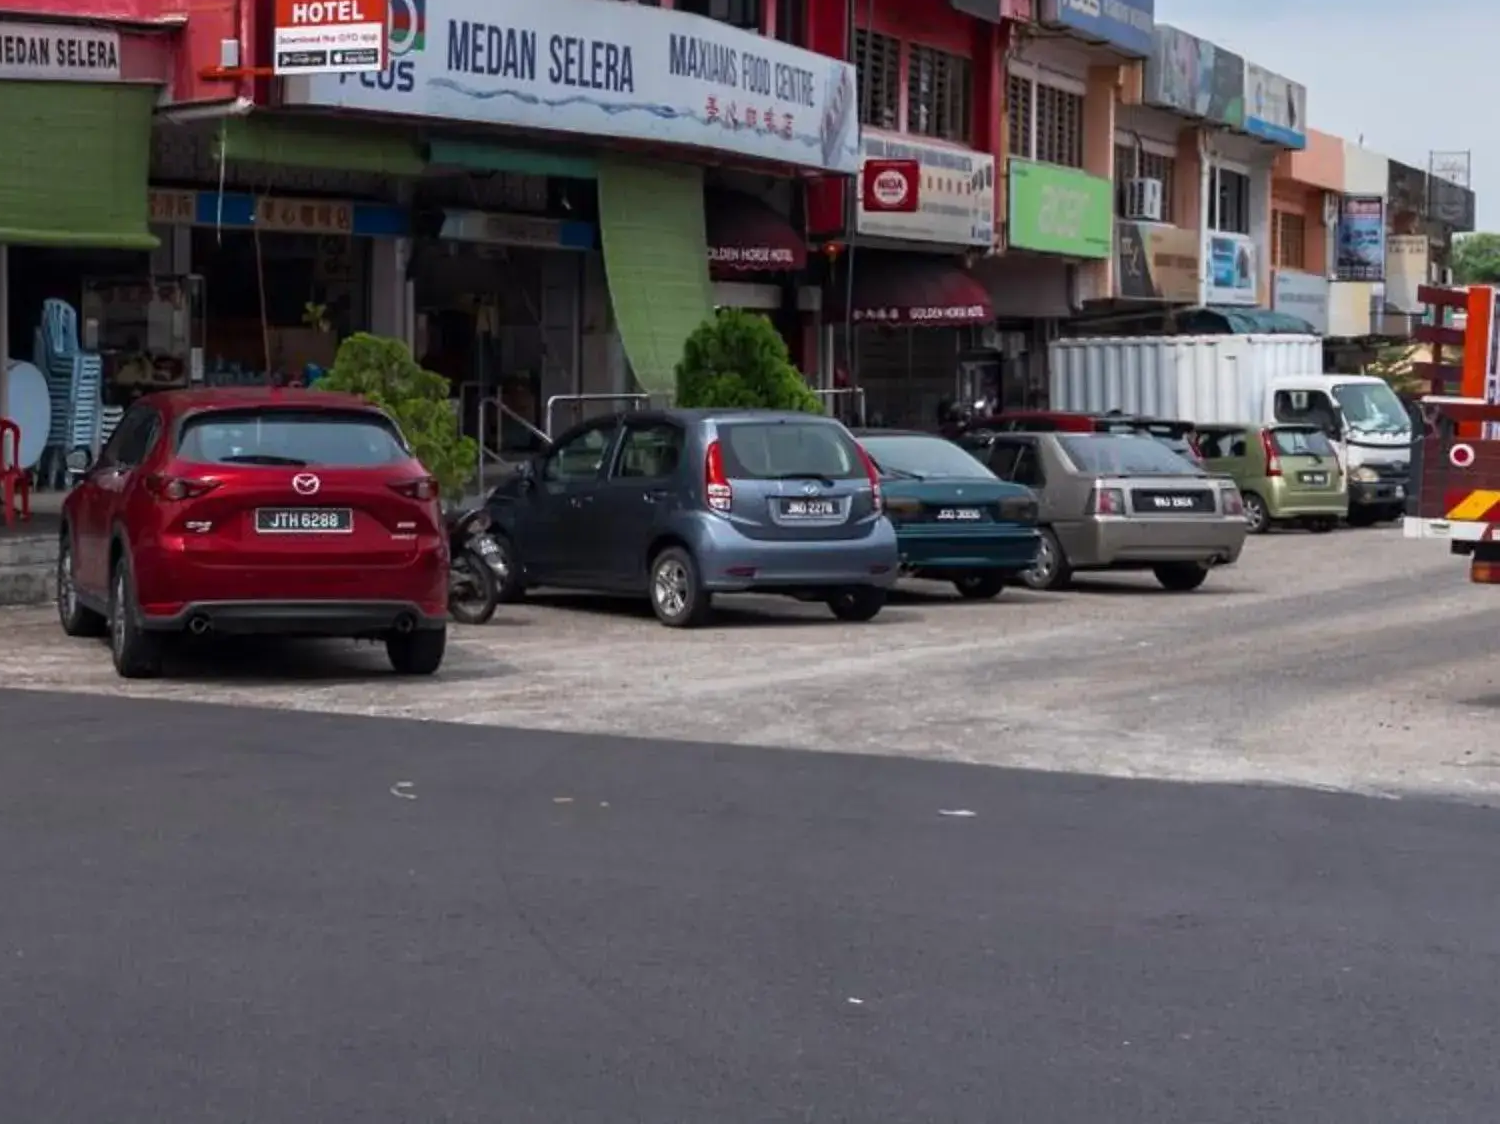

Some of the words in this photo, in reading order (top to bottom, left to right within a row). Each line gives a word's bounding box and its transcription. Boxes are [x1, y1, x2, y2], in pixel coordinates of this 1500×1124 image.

[292, 0, 364, 23] HOTEL
[56, 38, 117, 68] SELERA
[448, 19, 536, 81] MEDAN
[549, 34, 634, 93] SELERA
[742, 51, 771, 95] FOOD
[775, 62, 814, 108] CENTRE
[269, 512, 299, 528] JTH
[301, 513, 339, 528] 6288
